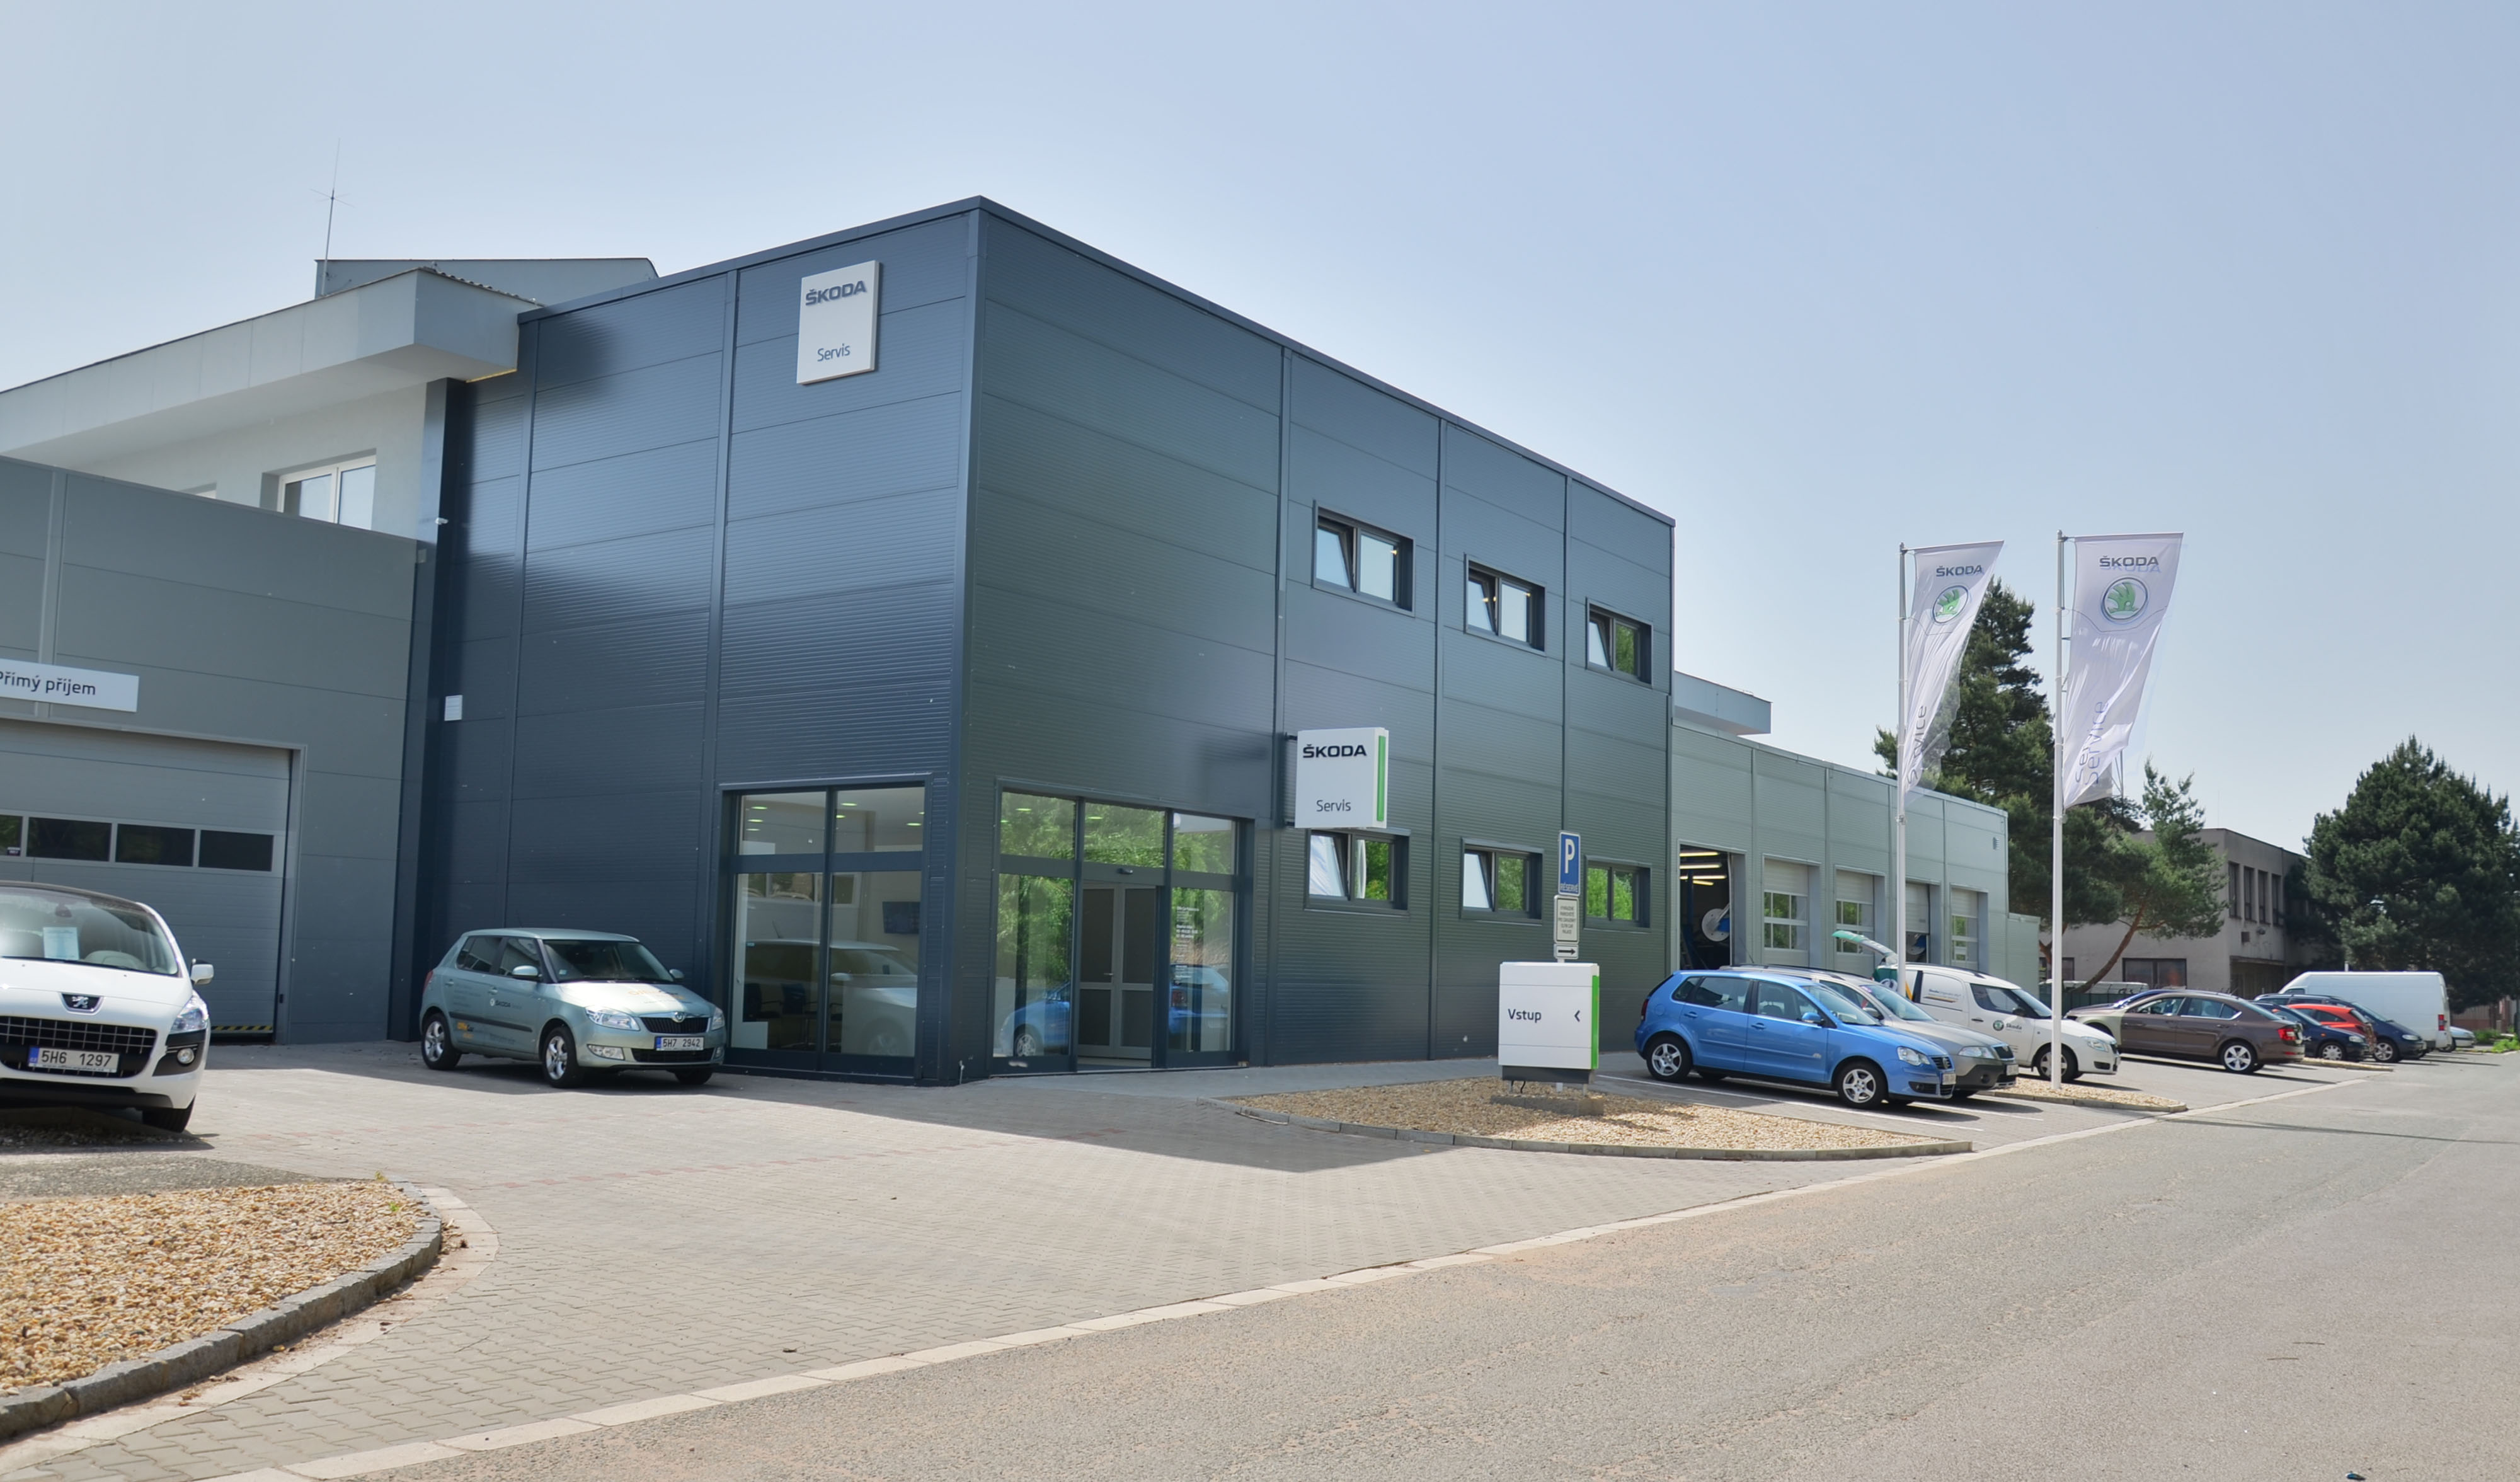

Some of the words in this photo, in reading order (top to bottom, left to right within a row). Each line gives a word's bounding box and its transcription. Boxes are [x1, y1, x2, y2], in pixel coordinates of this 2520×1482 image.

[806, 280, 867, 306] ŠKODA
[817, 343, 850, 362] Servis
[2099, 555, 2159, 567] ŠKODA
[1936, 565, 1983, 577] ŠKODA
[45, 677, 95, 696] příjem
[1303, 744, 1366, 758] ŠKODA
[1316, 799, 1351, 812] Servis
[1565, 839, 1575, 873] P
[1508, 1008, 1542, 1023] Vstup
[663, 1038, 677, 1047] 5H7
[682, 1038, 701, 1047] 2942
[42, 1050, 67, 1064] 5H6
[79, 1053, 112, 1067] 1297
